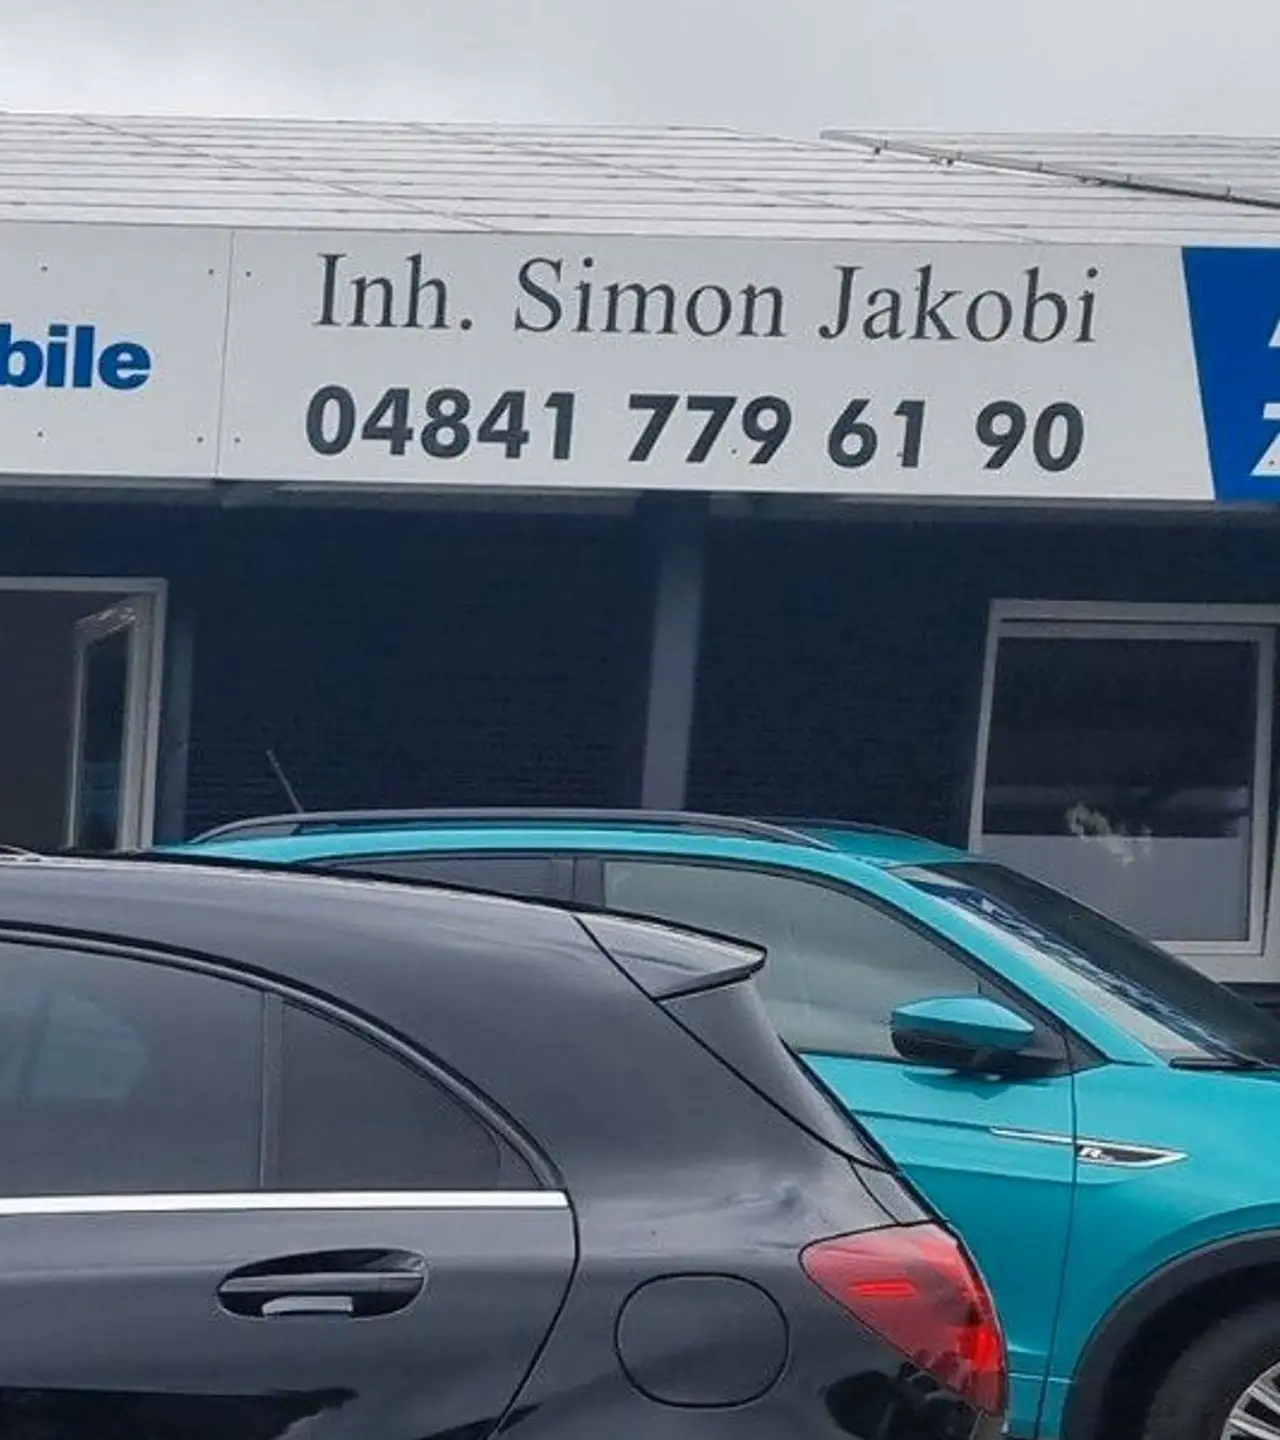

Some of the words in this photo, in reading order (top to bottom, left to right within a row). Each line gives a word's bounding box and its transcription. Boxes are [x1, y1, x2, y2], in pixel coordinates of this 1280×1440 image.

[316, 252, 473, 331] Inh.
[513, 256, 785, 338] Simon
[817, 263, 1099, 343] Jakobi
[305, 385, 575, 460] 04841
[627, 393, 793, 465] 779
[827, 399, 925, 469] 61
[974, 400, 1085, 472] 90
